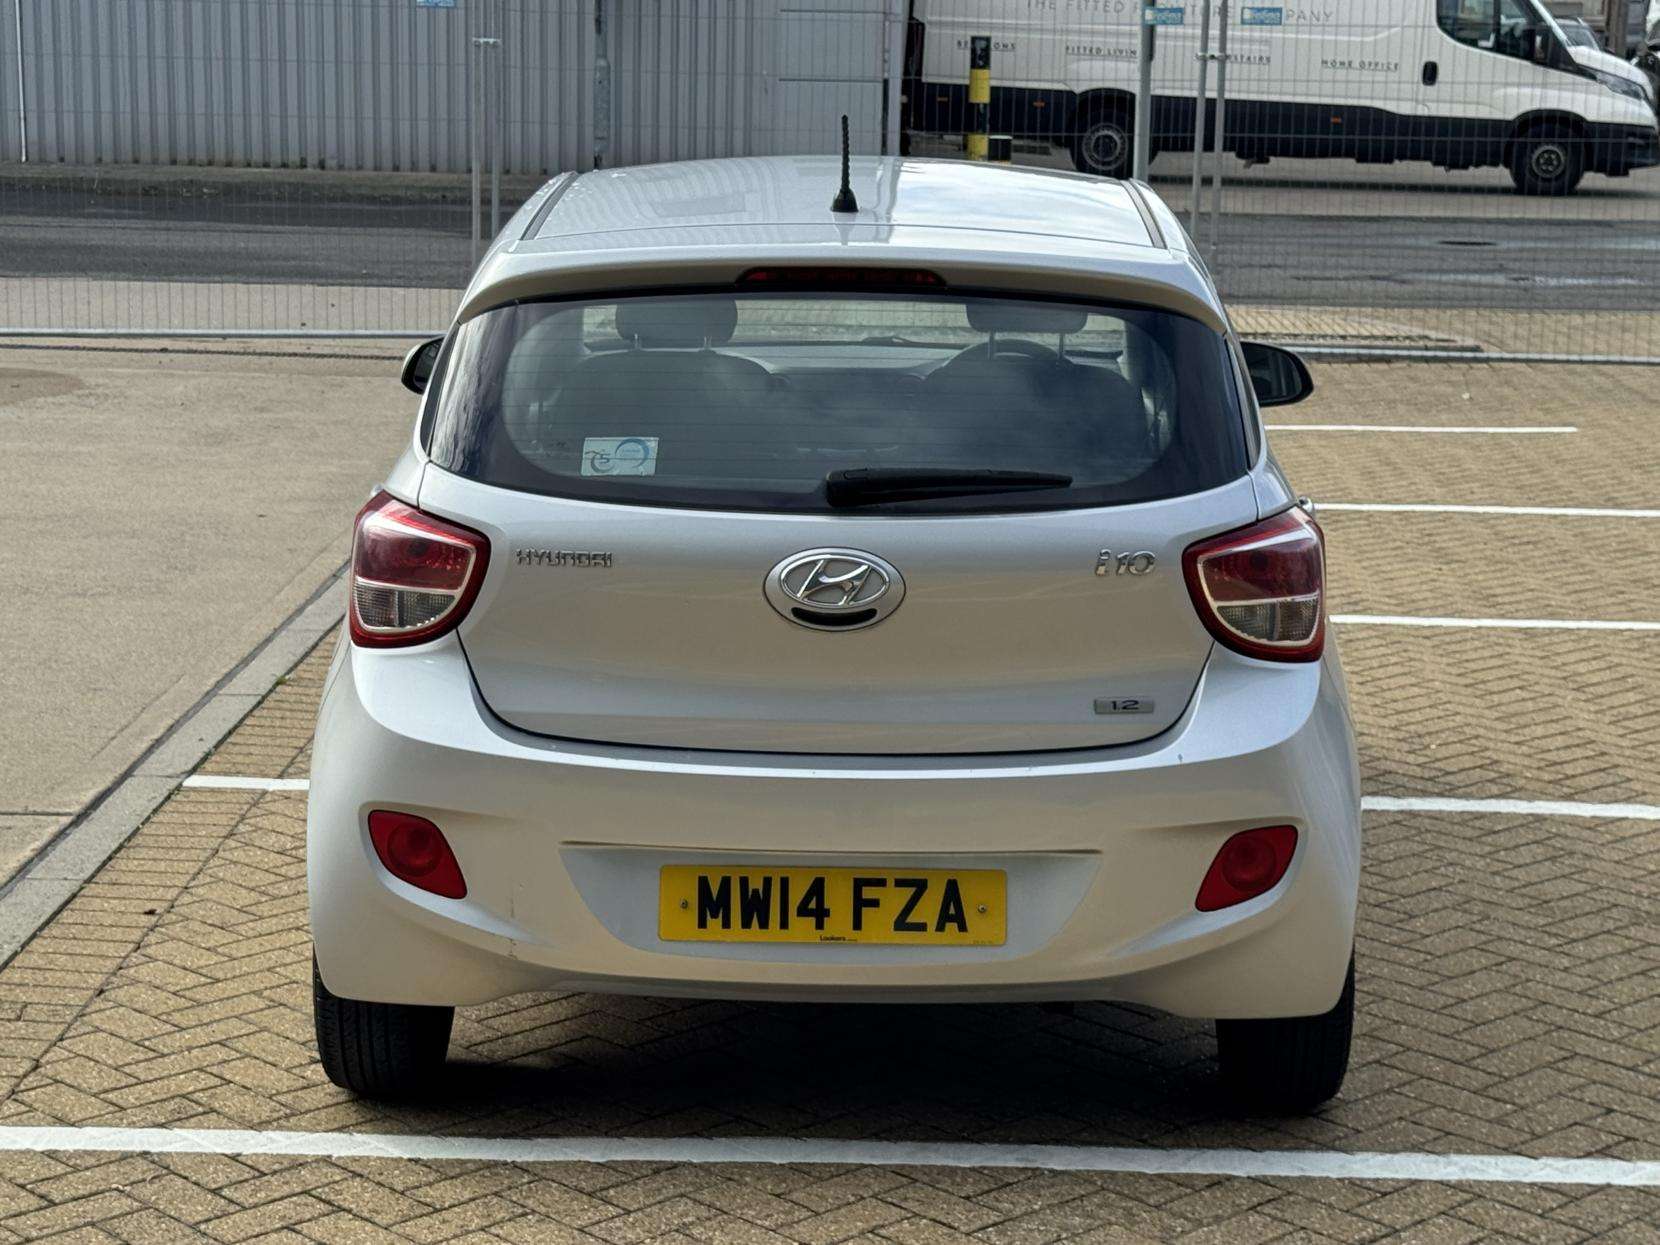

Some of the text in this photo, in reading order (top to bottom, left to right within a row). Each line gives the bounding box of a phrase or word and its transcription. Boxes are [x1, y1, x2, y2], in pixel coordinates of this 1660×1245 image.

[1321, 59, 1399, 71] HOME OFFICE
[515, 548, 613, 568] HYUNDAI
[1095, 549, 1156, 576] i10
[697, 875, 969, 933] MW14 FZA
